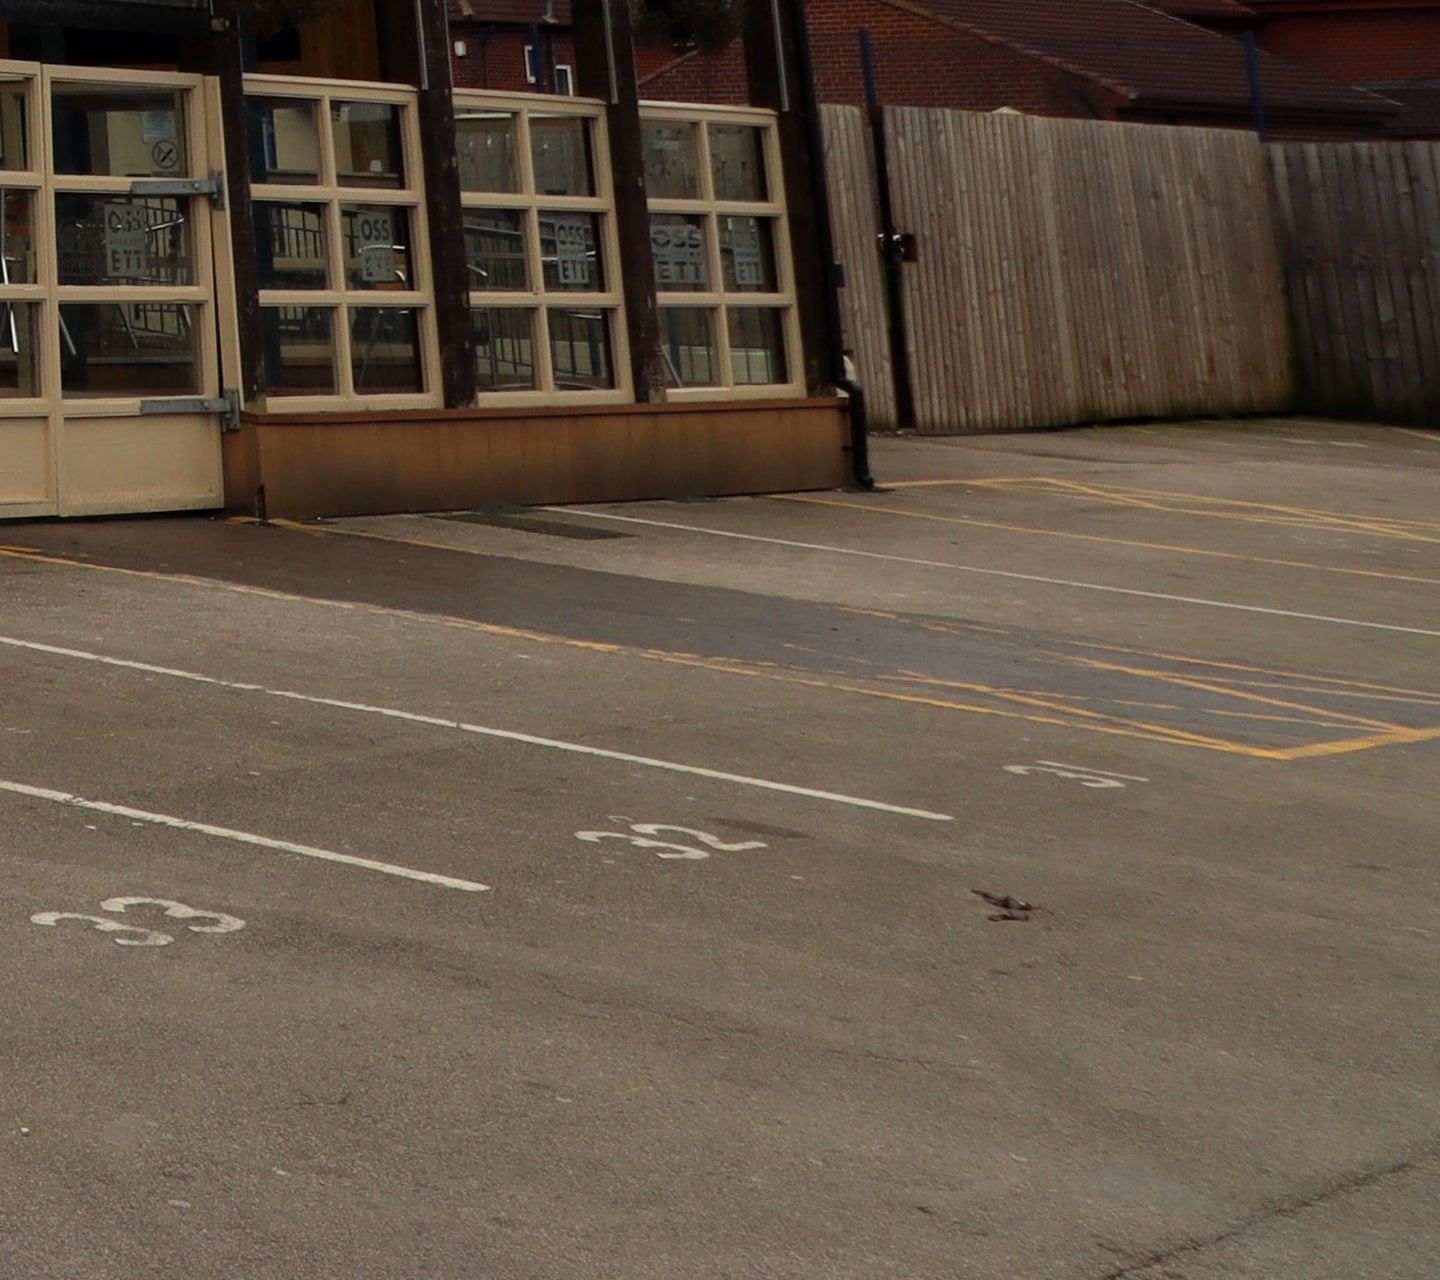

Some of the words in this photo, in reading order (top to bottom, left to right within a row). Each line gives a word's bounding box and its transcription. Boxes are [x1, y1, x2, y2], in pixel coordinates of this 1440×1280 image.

[361, 219, 389, 241] OSS
[574, 824, 768, 859] 32
[30, 896, 247, 946] 33
